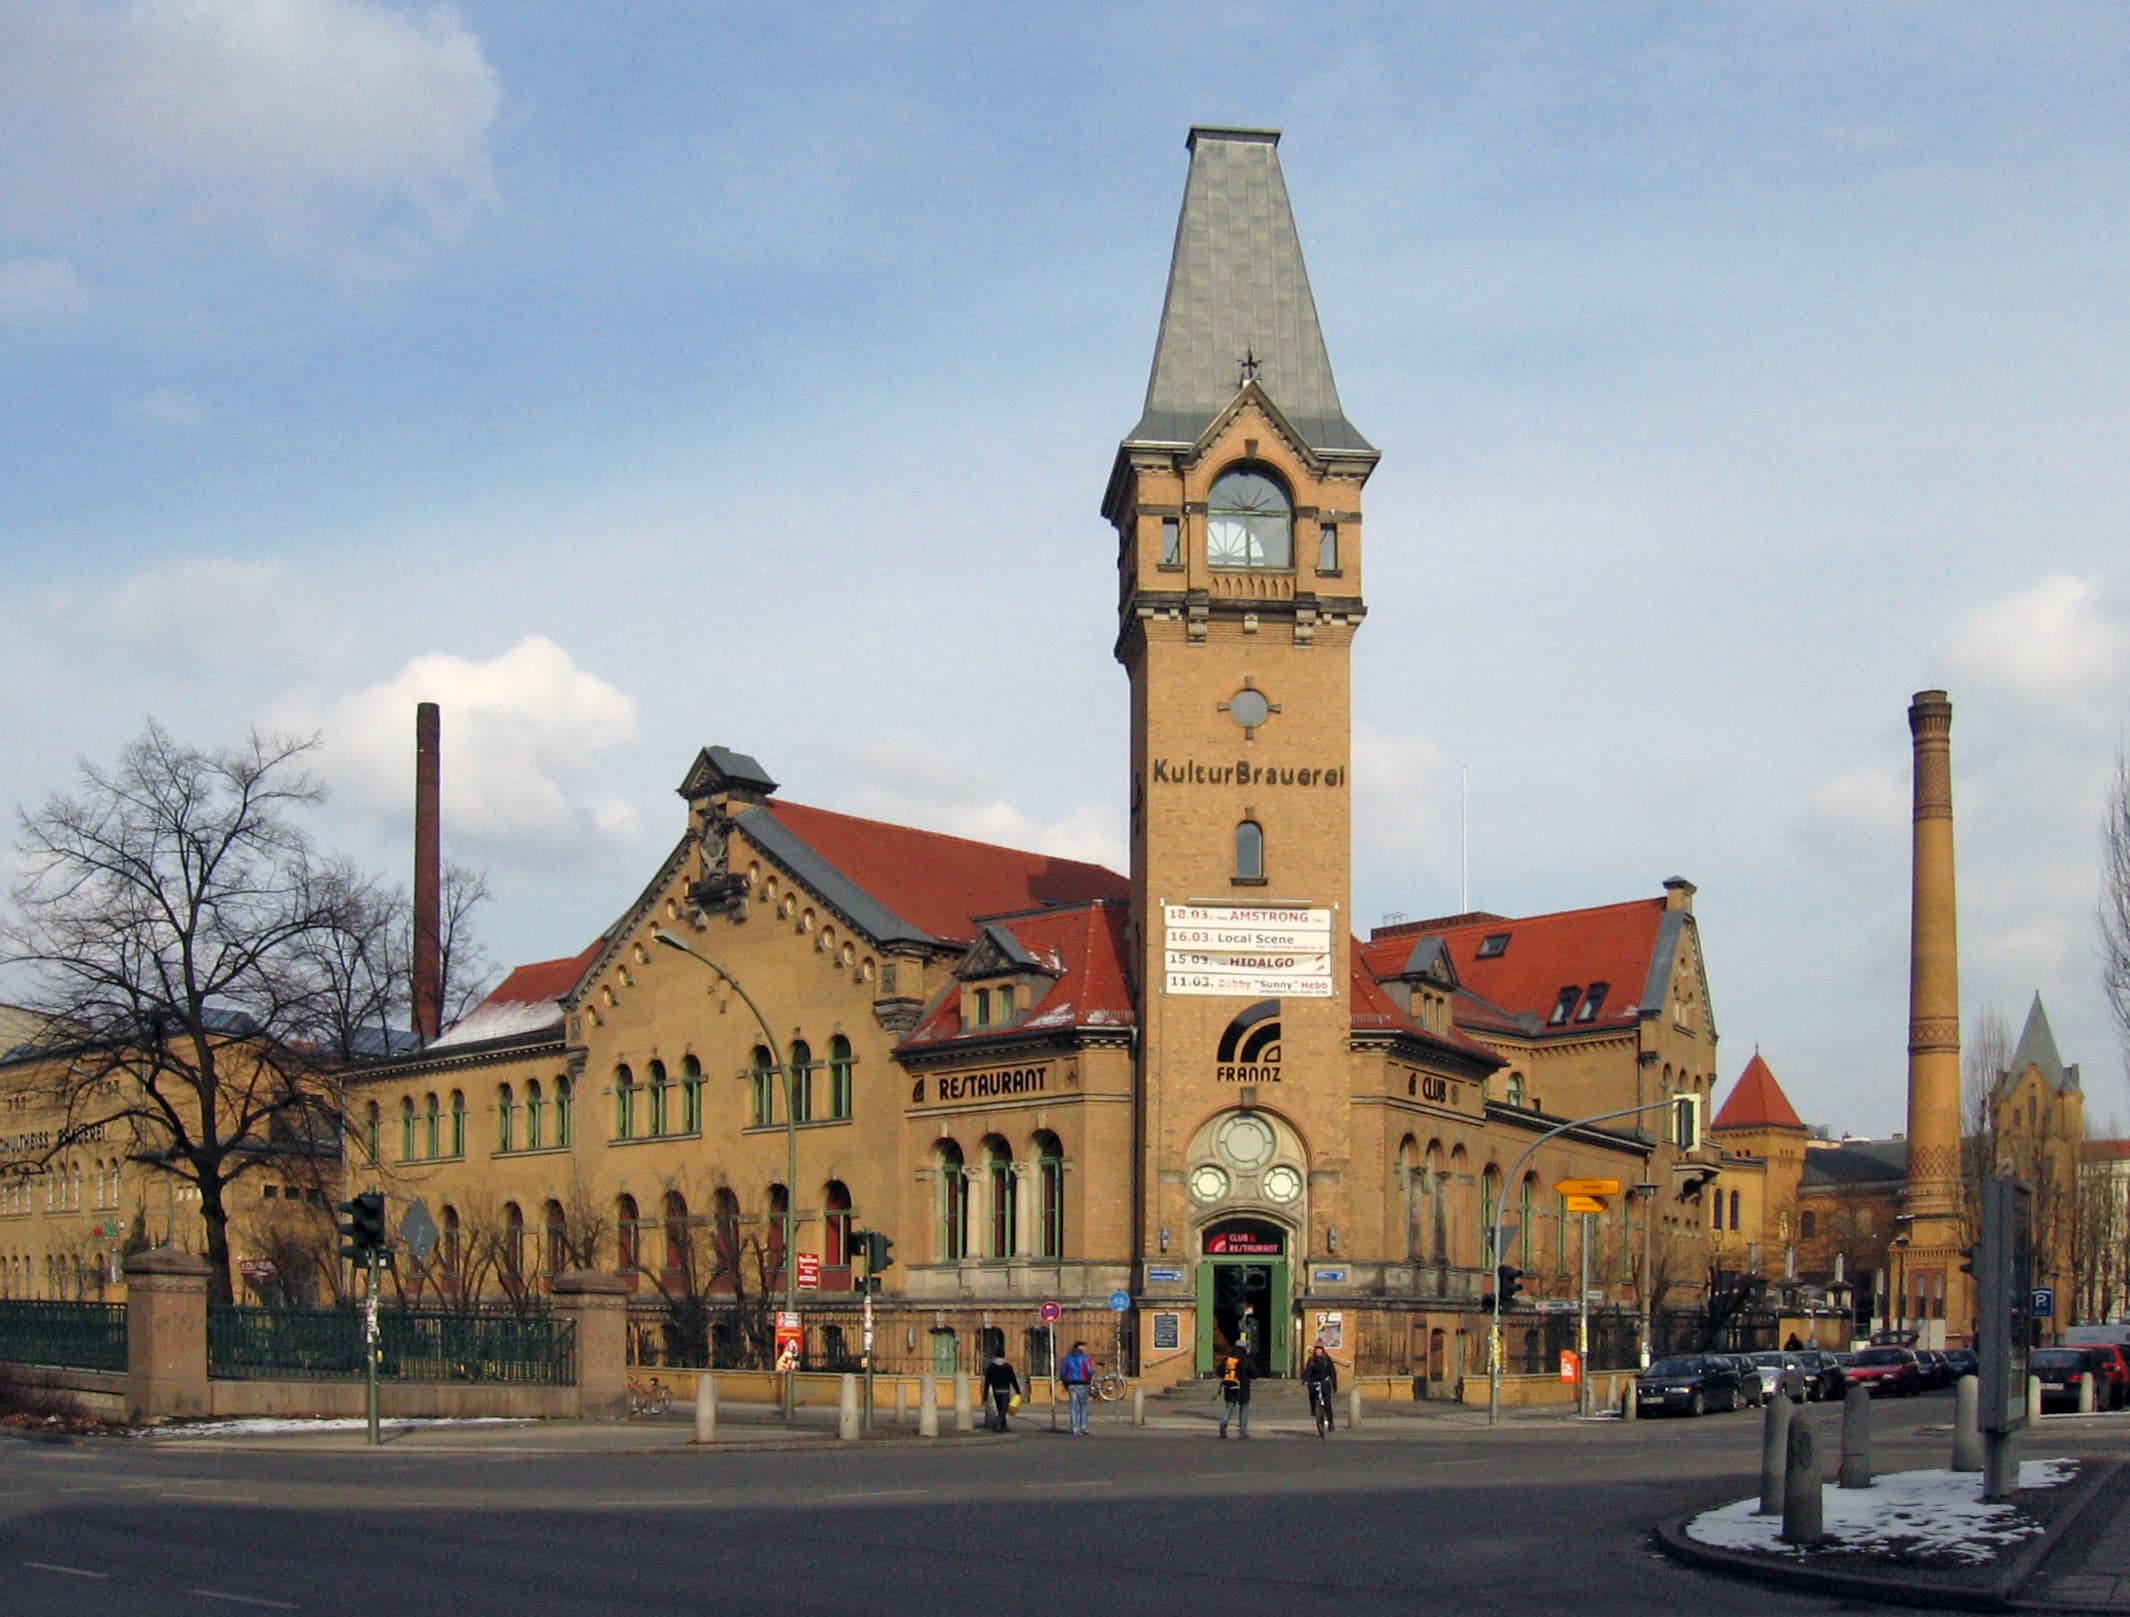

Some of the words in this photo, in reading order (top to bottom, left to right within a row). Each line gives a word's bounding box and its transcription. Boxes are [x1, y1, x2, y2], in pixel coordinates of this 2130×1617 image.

[1153, 758, 1345, 787] KulturBrauerei
[1169, 909, 1213, 920] 18.03.
[1230, 911, 1309, 923] AMSTRONG
[1170, 931, 1213, 943] 16.03.
[1217, 933, 1252, 944] Local
[1255, 934, 1294, 945] Scene
[1230, 957, 1295, 968] HIDALGO
[1171, 976, 1215, 988] 11.03.
[1301, 981, 1328, 990] Hebb
[1217, 1066, 1282, 1082] FRANNZ
[939, 1067, 1047, 1101] RESTAURANT
[1422, 1076, 1447, 1104] CLUB
[1228, 1233, 1249, 1242] CLUB
[1228, 1244, 1278, 1253] RESTAURANT
